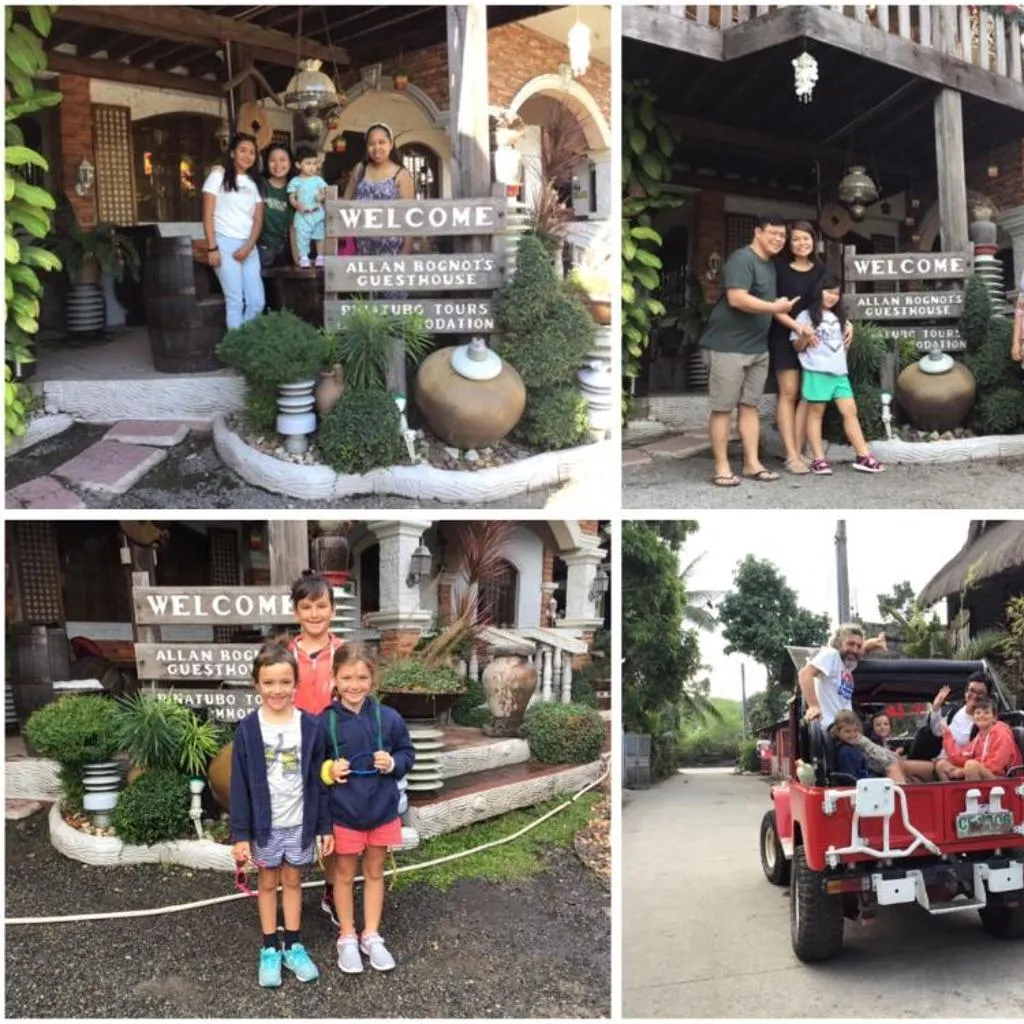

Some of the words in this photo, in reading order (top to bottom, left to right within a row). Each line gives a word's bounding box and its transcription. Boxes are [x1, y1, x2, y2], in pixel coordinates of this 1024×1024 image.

[339, 206, 494, 229] WELCOME
[345, 261, 406, 274] ALLAN
[854, 257, 965, 275] WELCOME
[356, 273, 478, 287] GUESTHOUSE
[857, 297, 900, 306] ALLAN
[434, 303, 488, 316] TOURS
[864, 305, 950, 316] GUESTHOUSE
[147, 594, 295, 616] WELCOME
[156, 650, 213, 662] ALLAN
